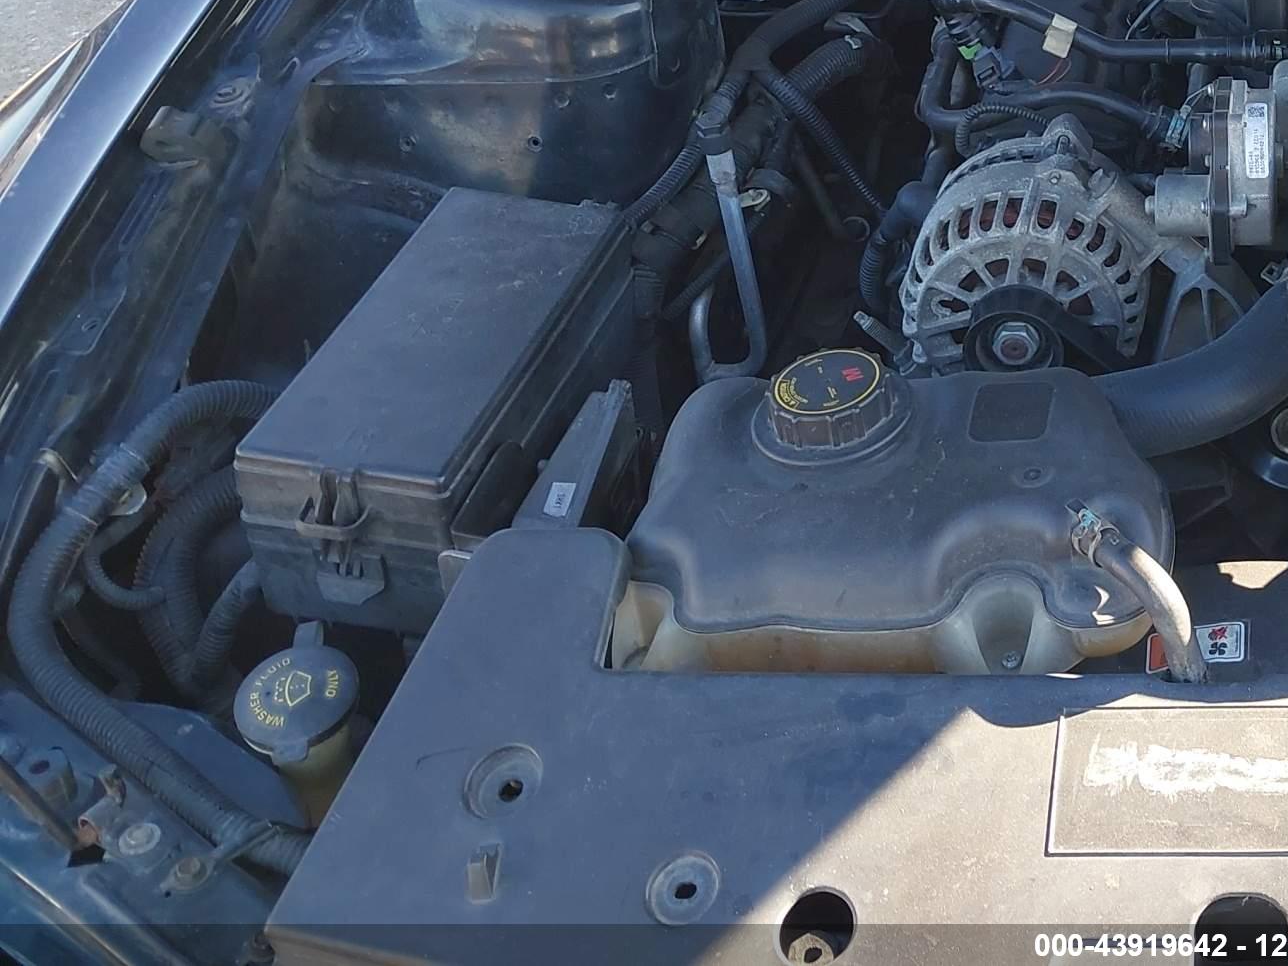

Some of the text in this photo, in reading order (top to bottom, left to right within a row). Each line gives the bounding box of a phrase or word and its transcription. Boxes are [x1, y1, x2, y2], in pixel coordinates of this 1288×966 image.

[249, 657, 340, 727] WASHER FLUID ONLY
